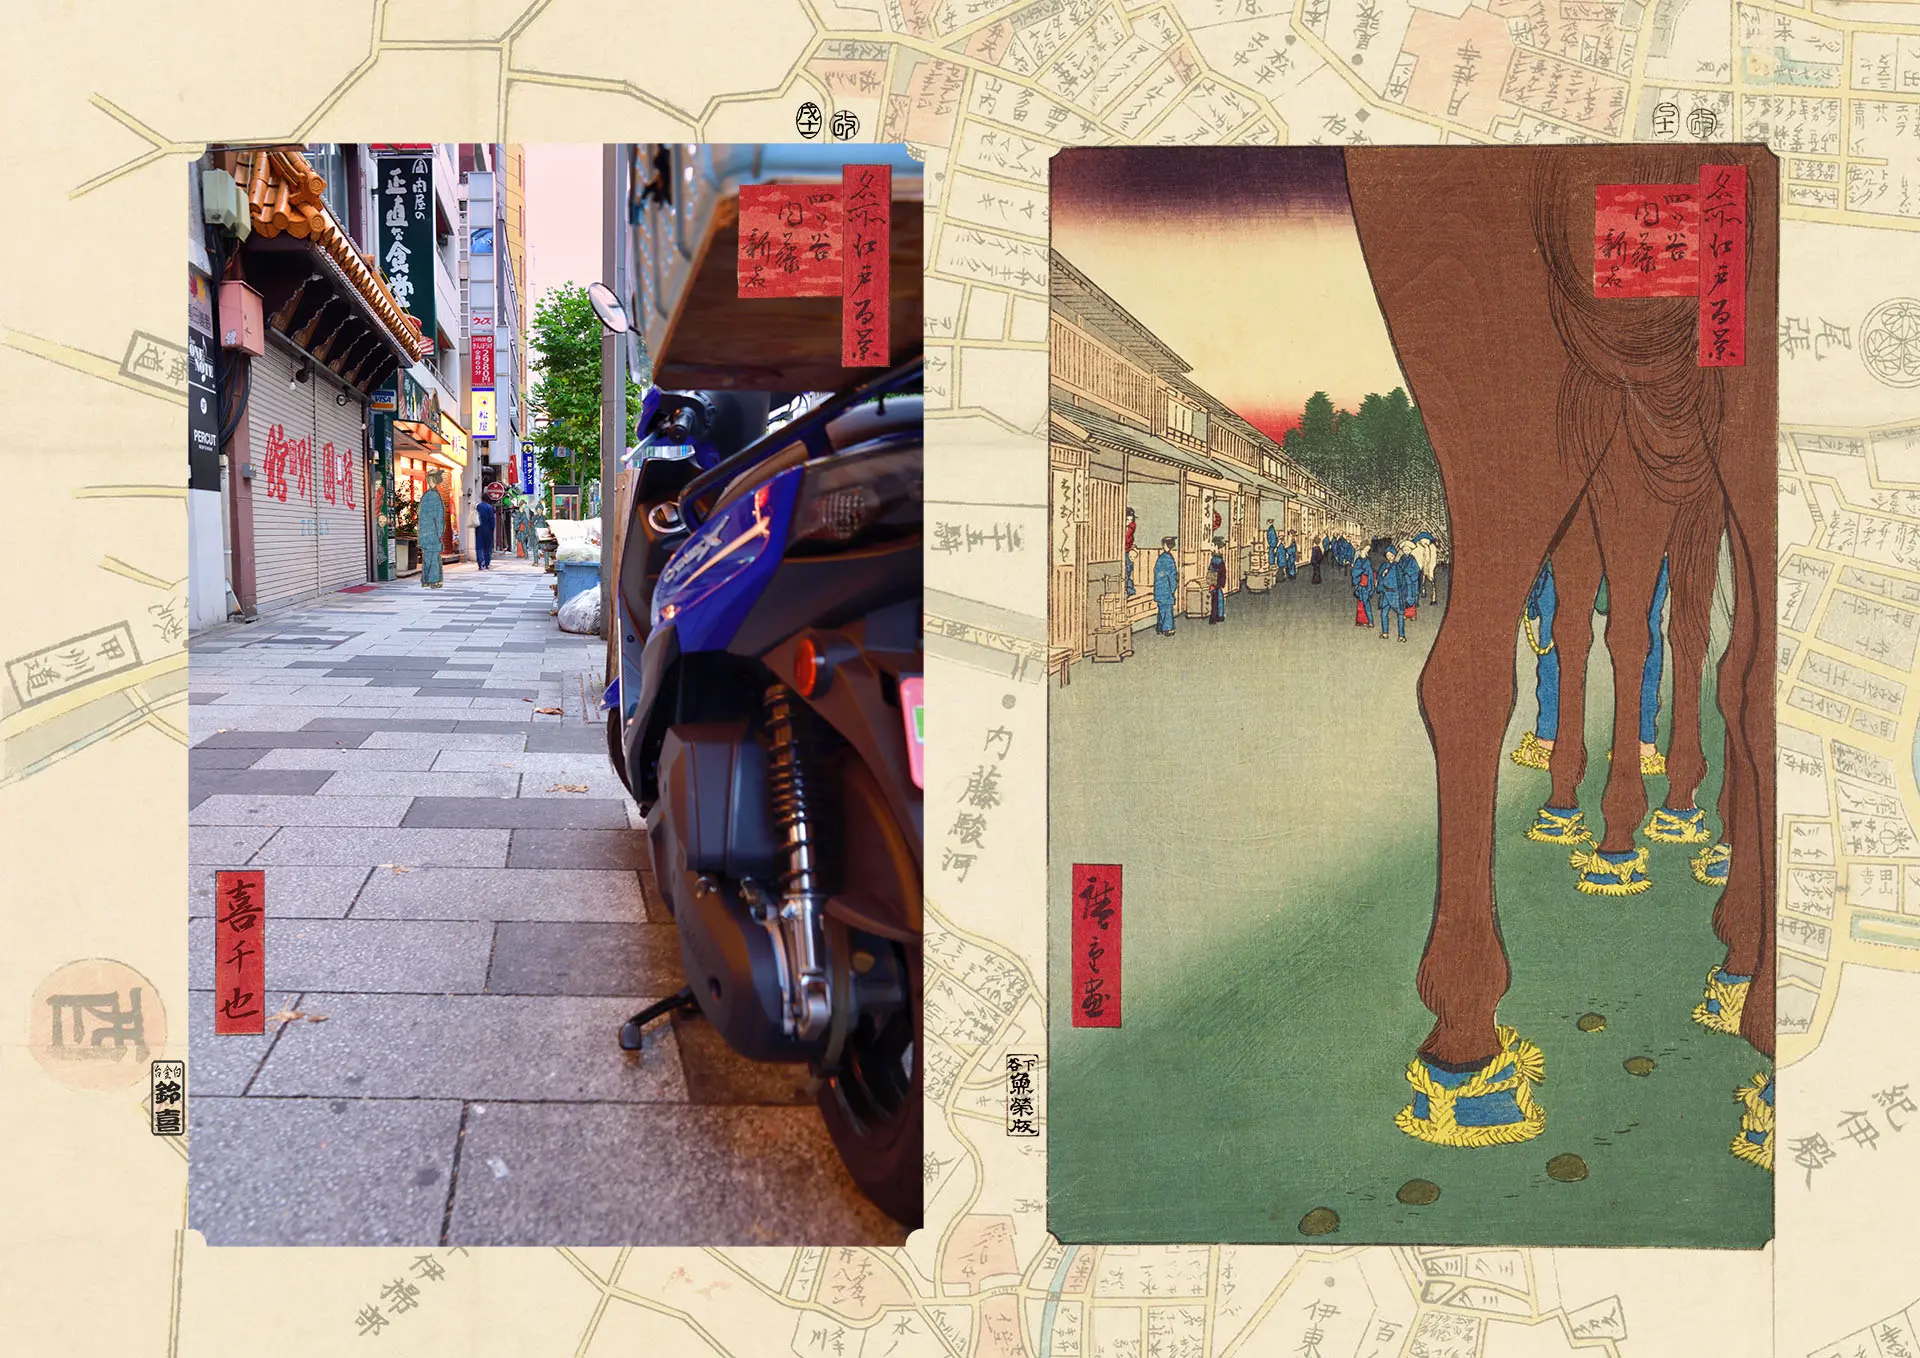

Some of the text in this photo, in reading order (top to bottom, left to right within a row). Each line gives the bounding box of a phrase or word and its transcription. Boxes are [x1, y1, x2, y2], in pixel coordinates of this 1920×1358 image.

[412, 176, 427, 220] 肉屋の
[385, 167, 414, 309] 正直な食堂
[1780, 315, 1854, 362] 尾張
[195, 359, 214, 379] NOTE
[374, 395, 392, 403] VISA
[193, 429, 217, 447] PERCUT
[23, 634, 126, 698] 甲州道
[941, 724, 1014, 884] 内藤駿河
[1787, 1082, 1918, 1193] 紀伊殿
